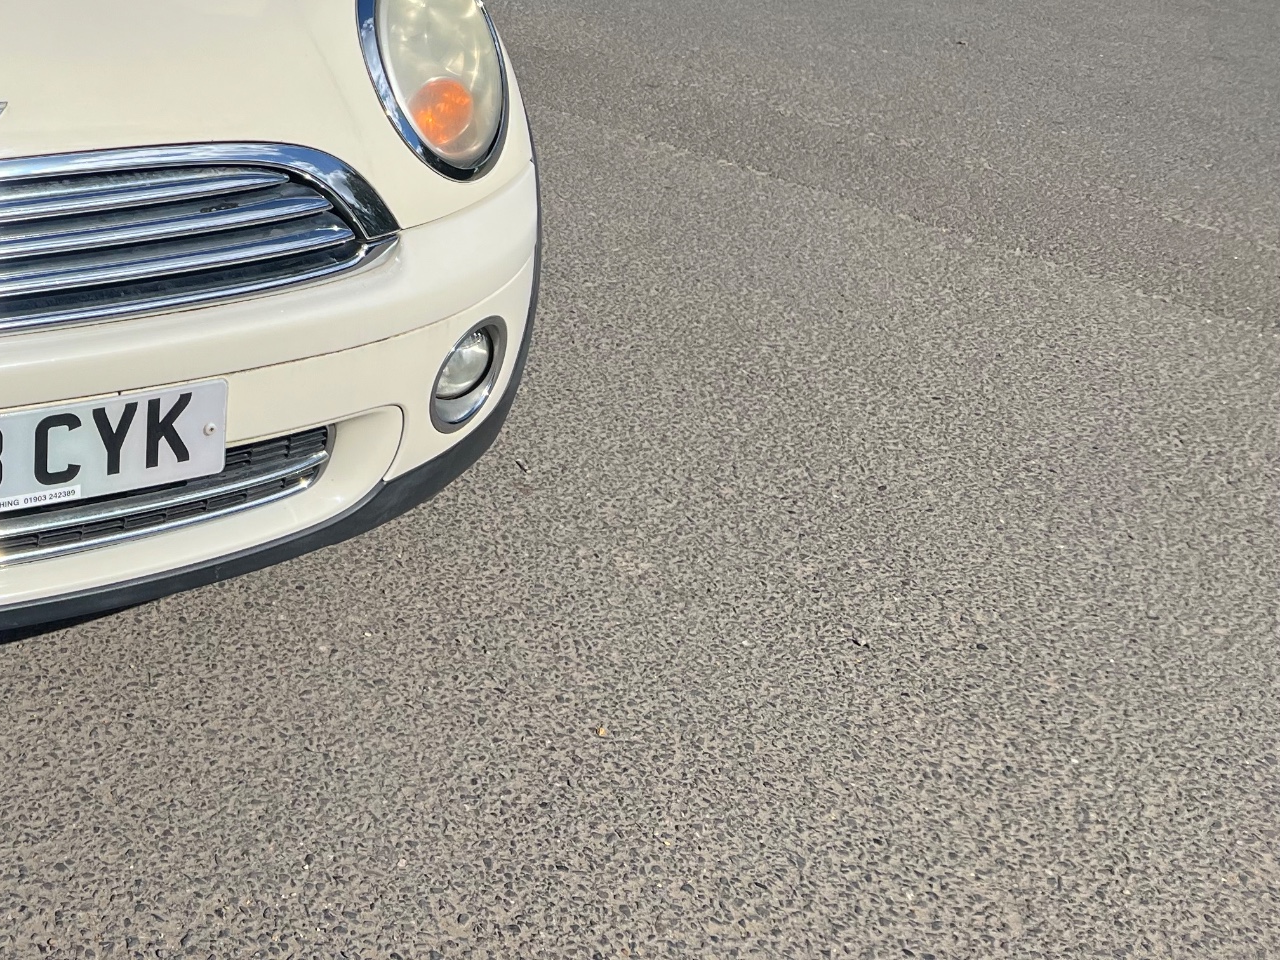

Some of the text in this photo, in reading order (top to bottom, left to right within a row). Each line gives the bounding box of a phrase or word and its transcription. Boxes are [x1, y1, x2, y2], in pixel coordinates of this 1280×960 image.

[34, 392, 194, 487] CYK
[24, 495, 46, 504] 01903
[49, 490, 75, 500] 242389
